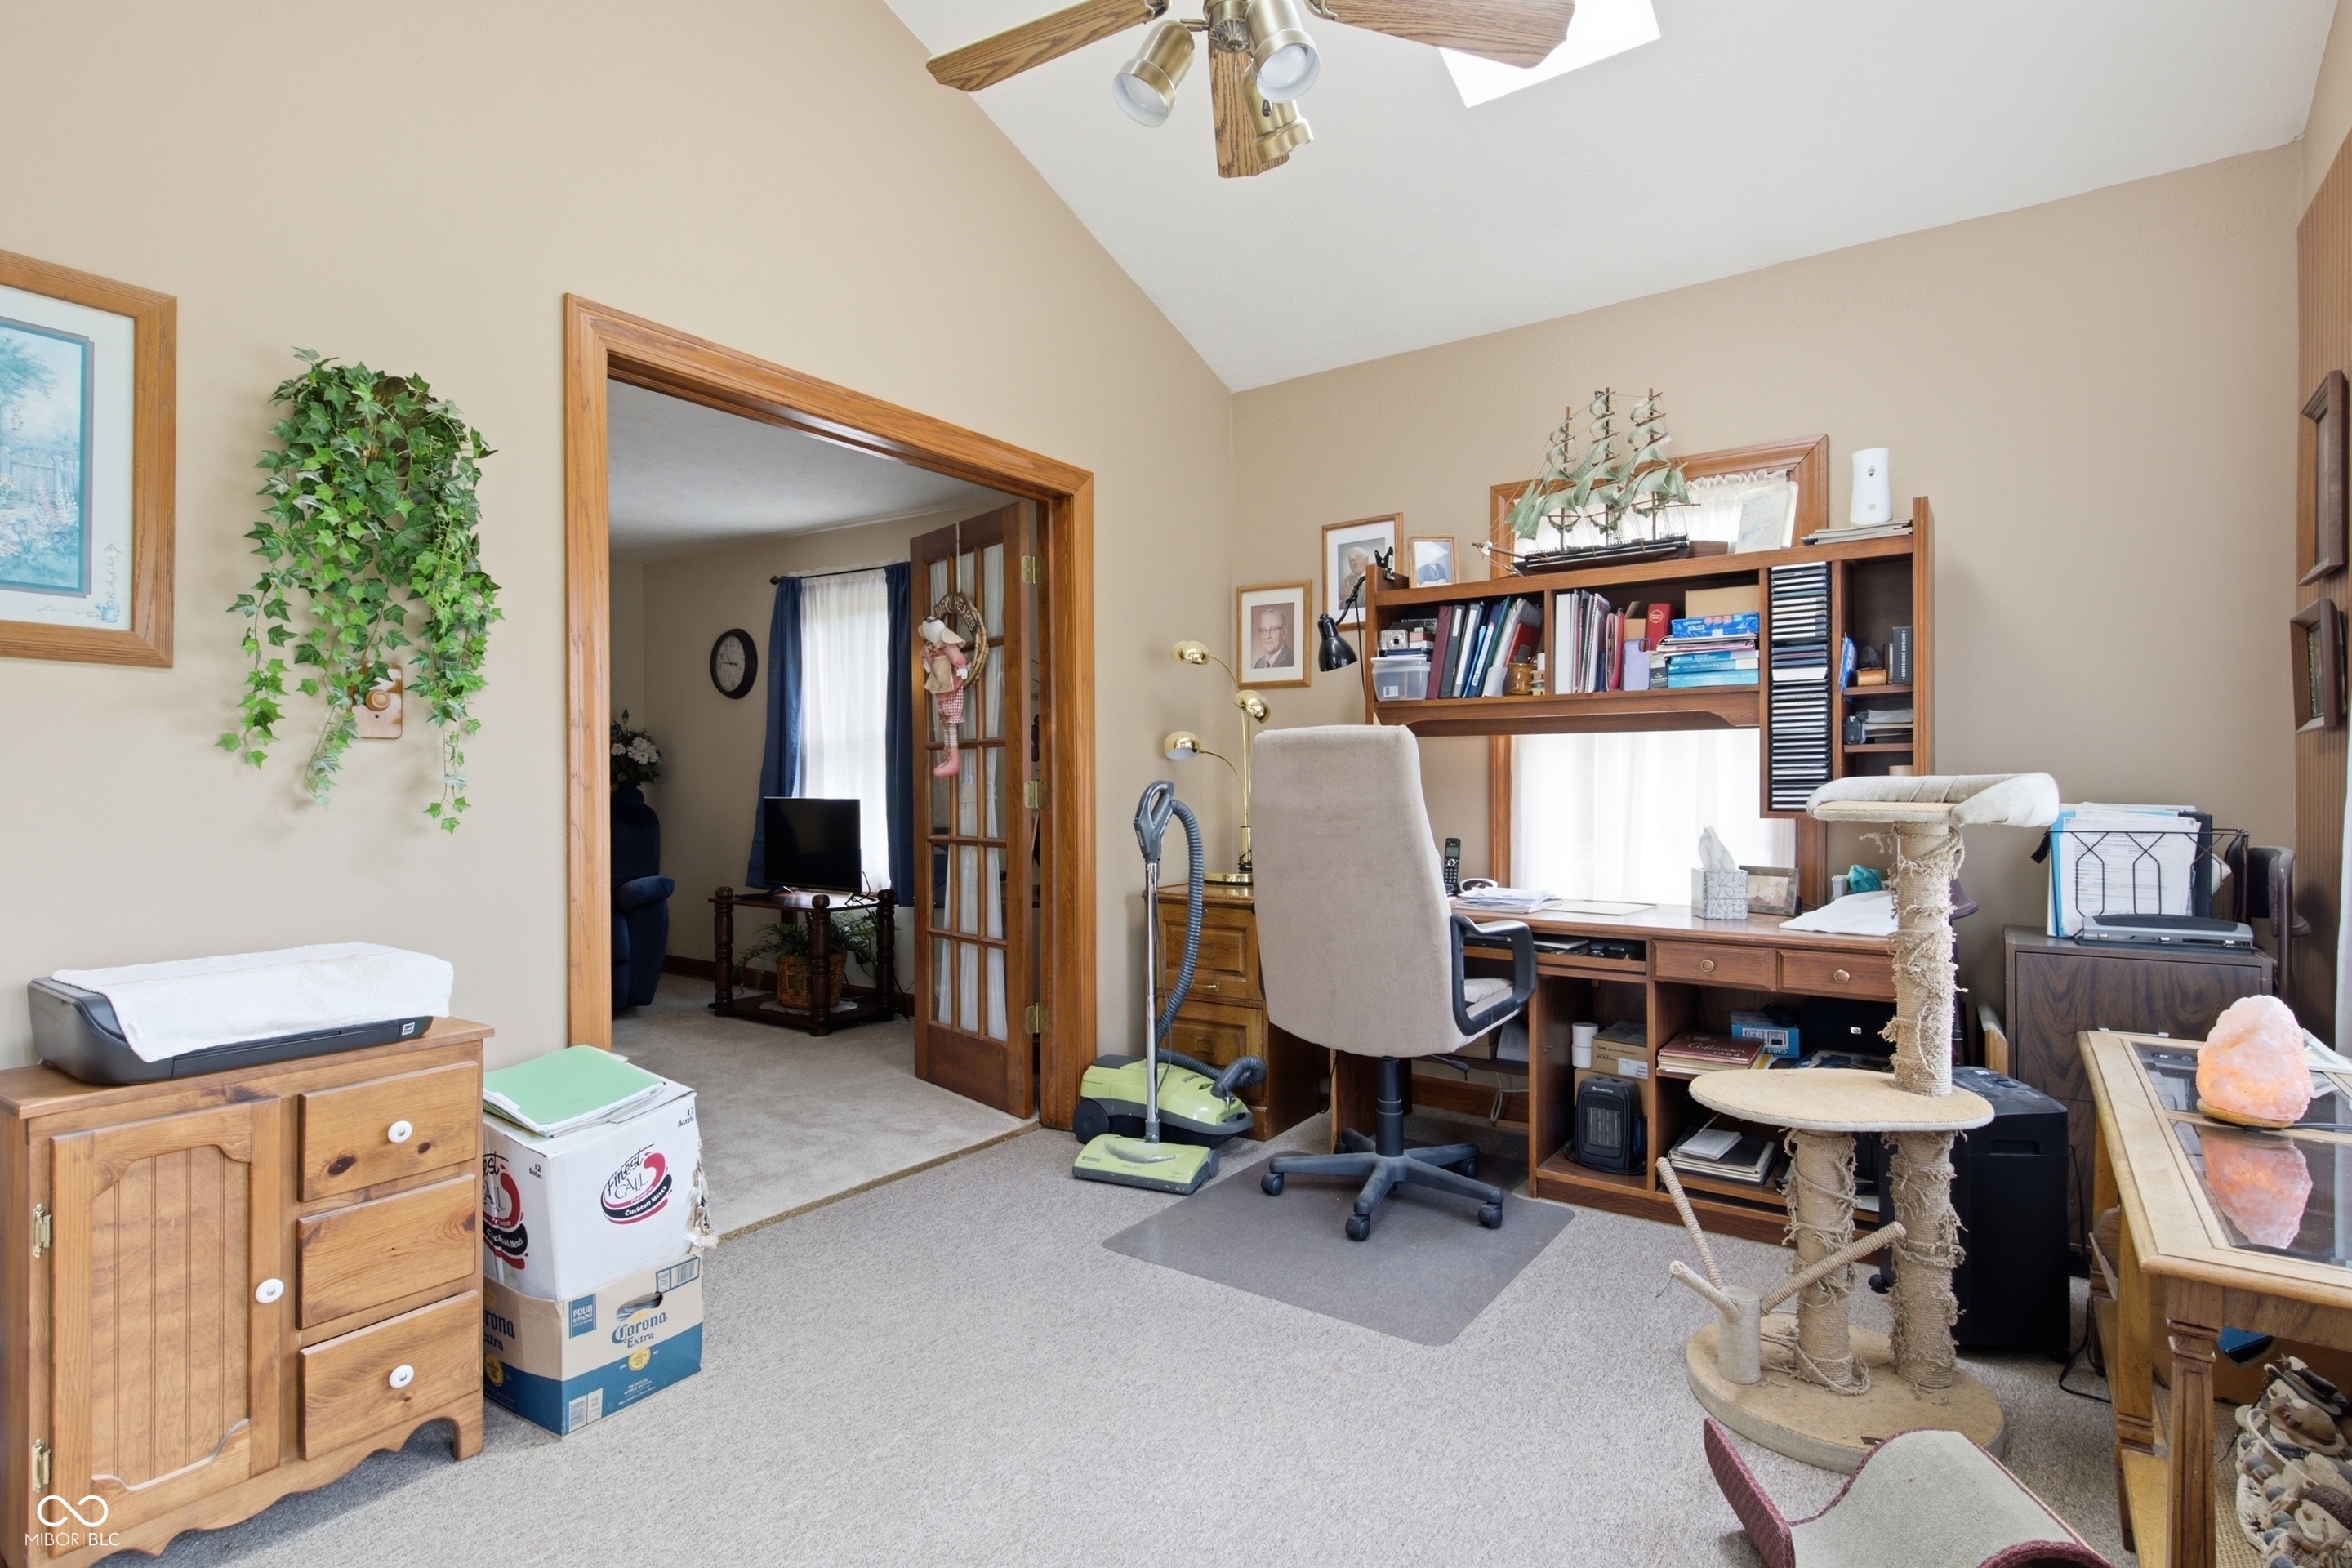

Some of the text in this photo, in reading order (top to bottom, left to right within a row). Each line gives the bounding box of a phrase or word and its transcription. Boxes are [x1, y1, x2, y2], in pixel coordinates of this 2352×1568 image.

[606, 1147, 644, 1197] Finest
[614, 1173, 649, 1199] CALL
[572, 1304, 593, 1318] FOUR
[611, 1312, 668, 1344] Corona
[627, 1332, 654, 1348] Extra
